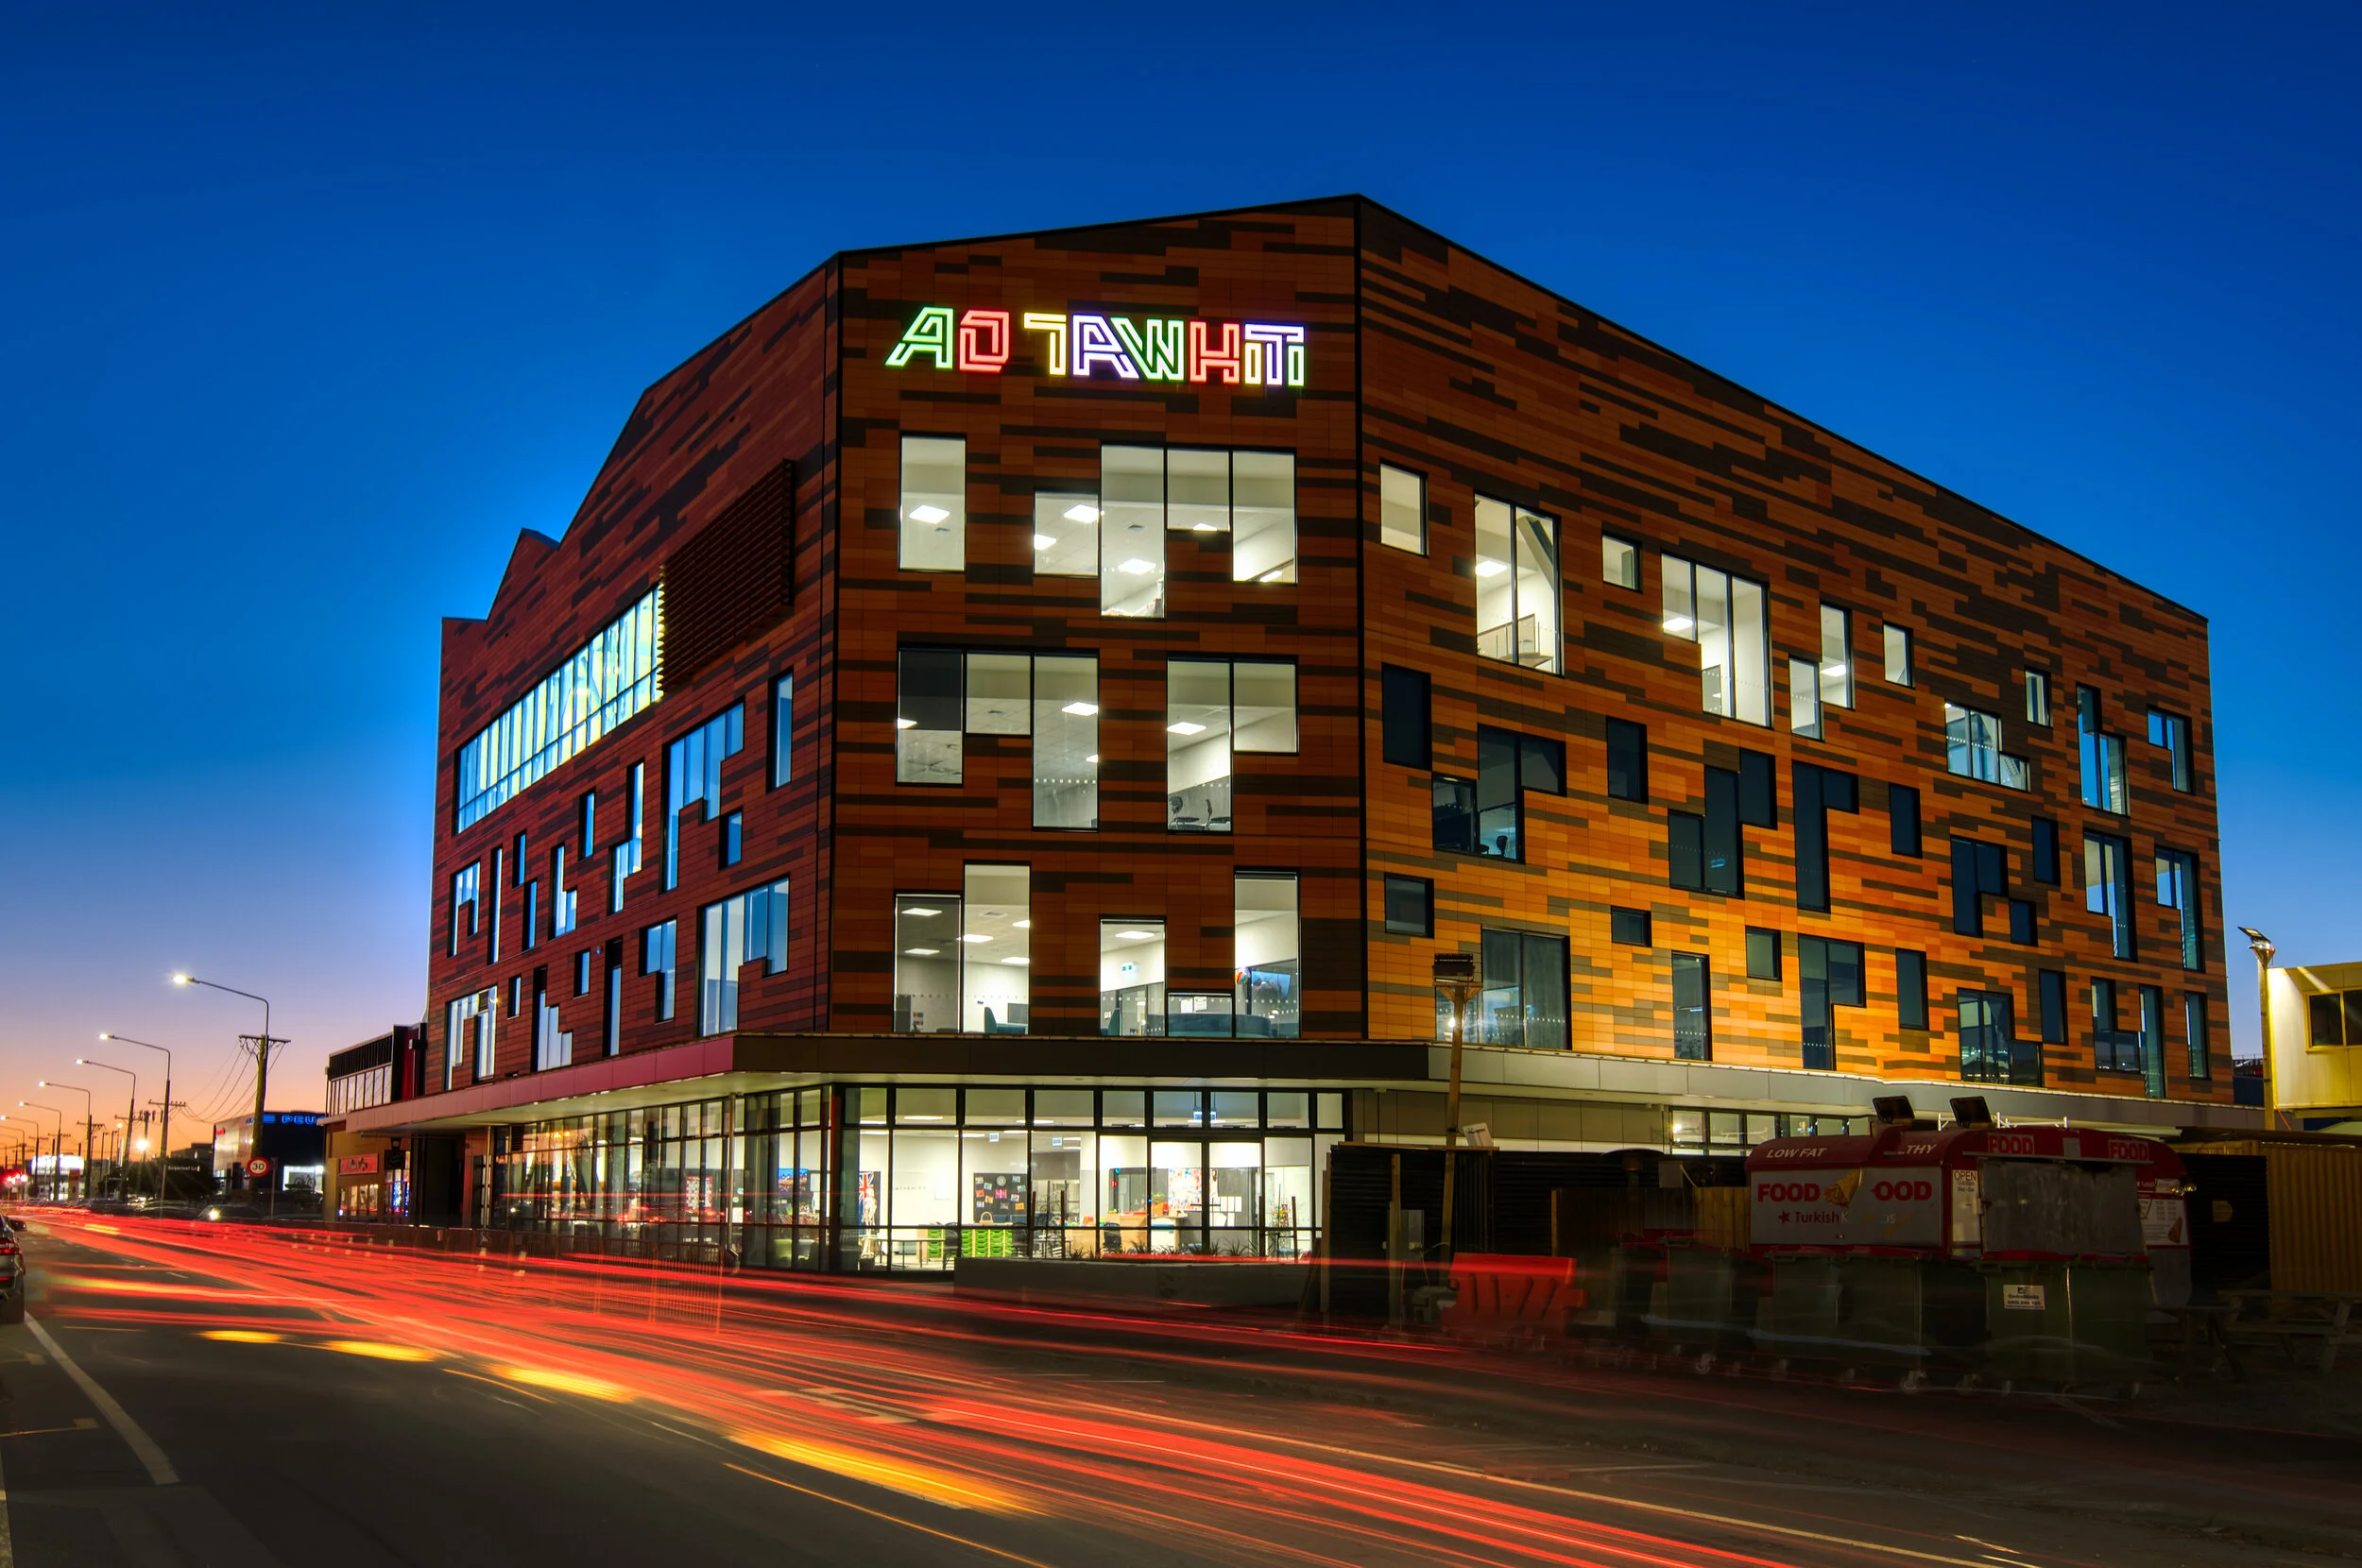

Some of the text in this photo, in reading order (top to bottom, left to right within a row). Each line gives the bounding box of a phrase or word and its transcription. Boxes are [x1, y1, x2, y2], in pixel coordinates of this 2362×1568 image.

[884, 306, 1010, 373] AO
[282, 1115, 325, 1125] PEU
[1766, 1147, 1827, 1158] LOW FAT
[1898, 1144, 1937, 1154] THY
[1989, 1135, 2033, 1155] FOOD
[2110, 1142, 2149, 1160] FOOD
[1954, 1170, 1977, 1181] OPEN
[1757, 1184, 1821, 1202] FOOD
[1871, 1181, 1932, 1202] OOD
[1796, 1211, 1840, 1224] Turkish
